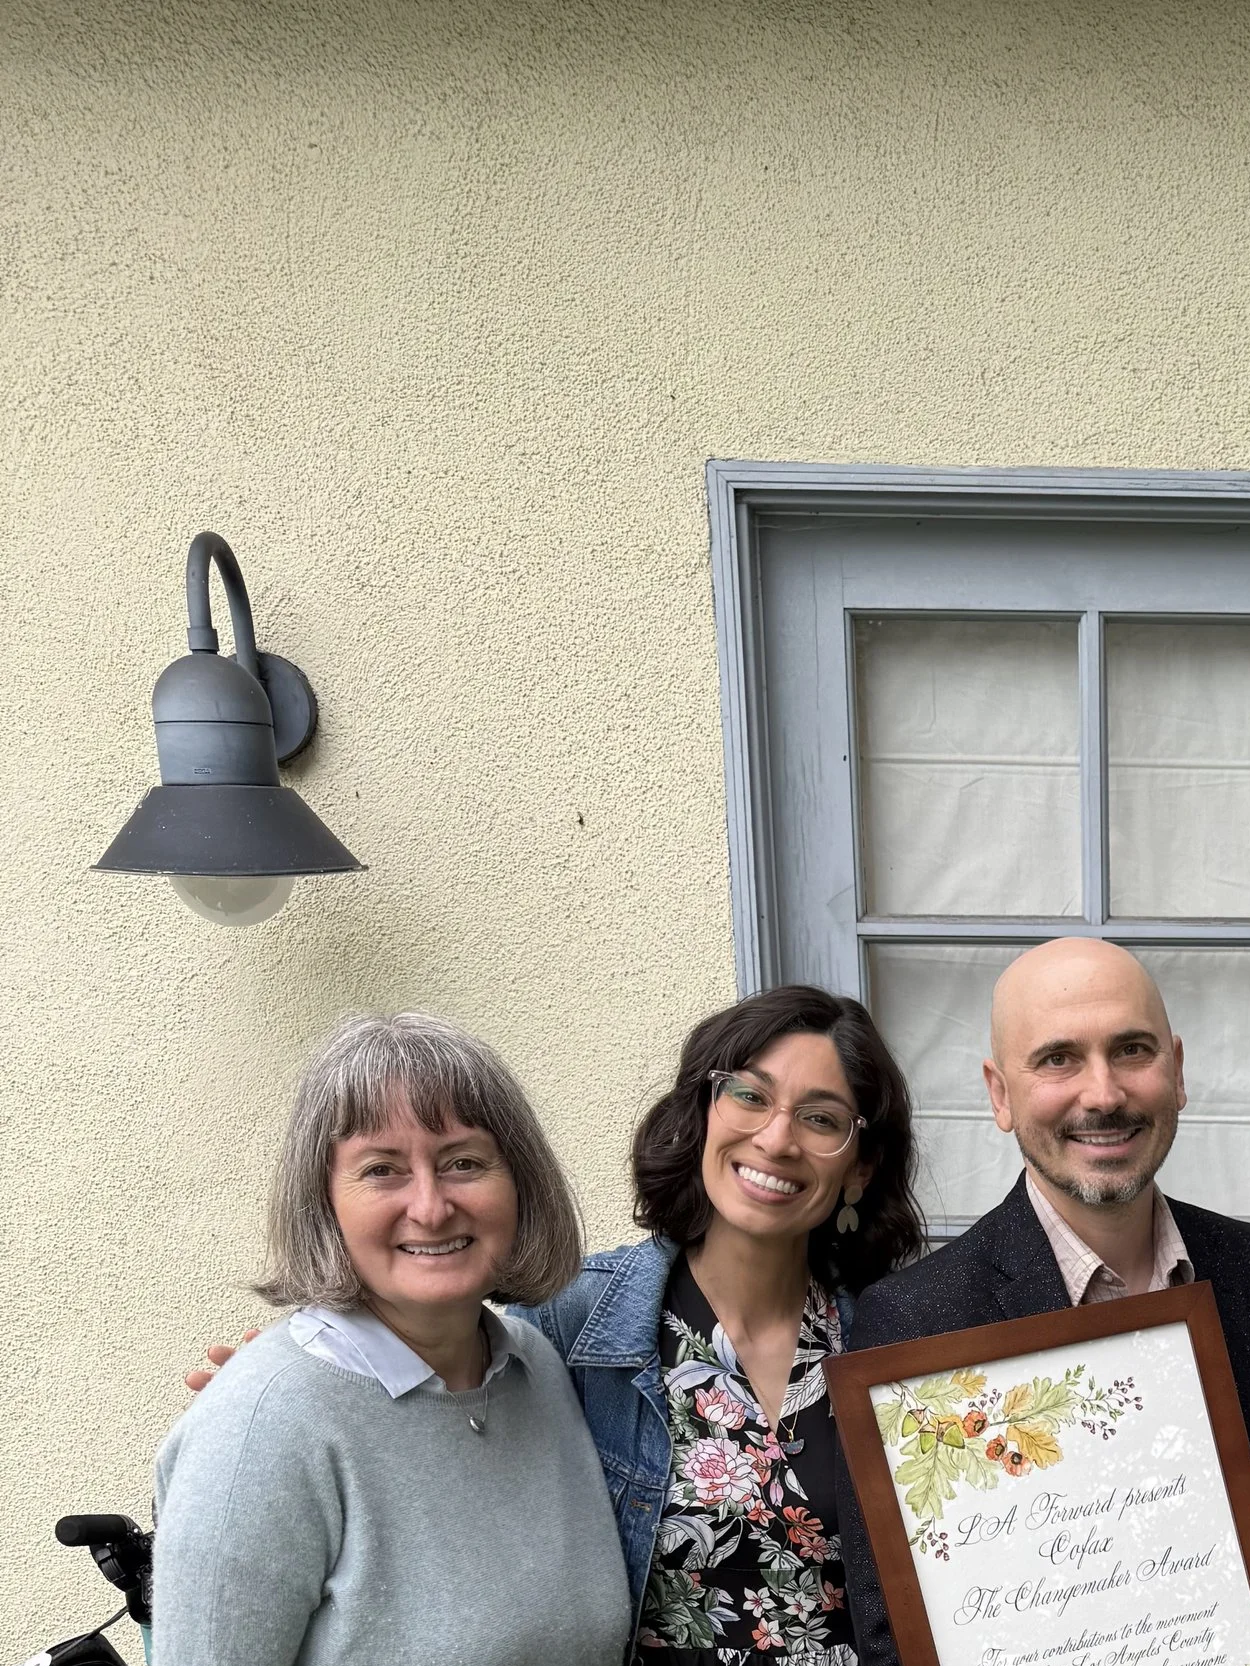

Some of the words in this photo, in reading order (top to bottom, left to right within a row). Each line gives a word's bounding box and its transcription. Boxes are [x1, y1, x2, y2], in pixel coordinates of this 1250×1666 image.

[1025, 1488, 1117, 1530] Forward
[1118, 1473, 1190, 1521] presents
[1038, 1524, 1114, 1570] Cofax
[953, 1585, 1003, 1626] The
[1004, 1560, 1132, 1618] Changemaker
[1136, 1543, 1217, 1582] Award
[1042, 1629, 1118, 1660] contributions
[1119, 1623, 1134, 1641] to
[1134, 1612, 1154, 1635] the
[1156, 1601, 1220, 1630] movement
[1162, 1627, 1217, 1652] County
